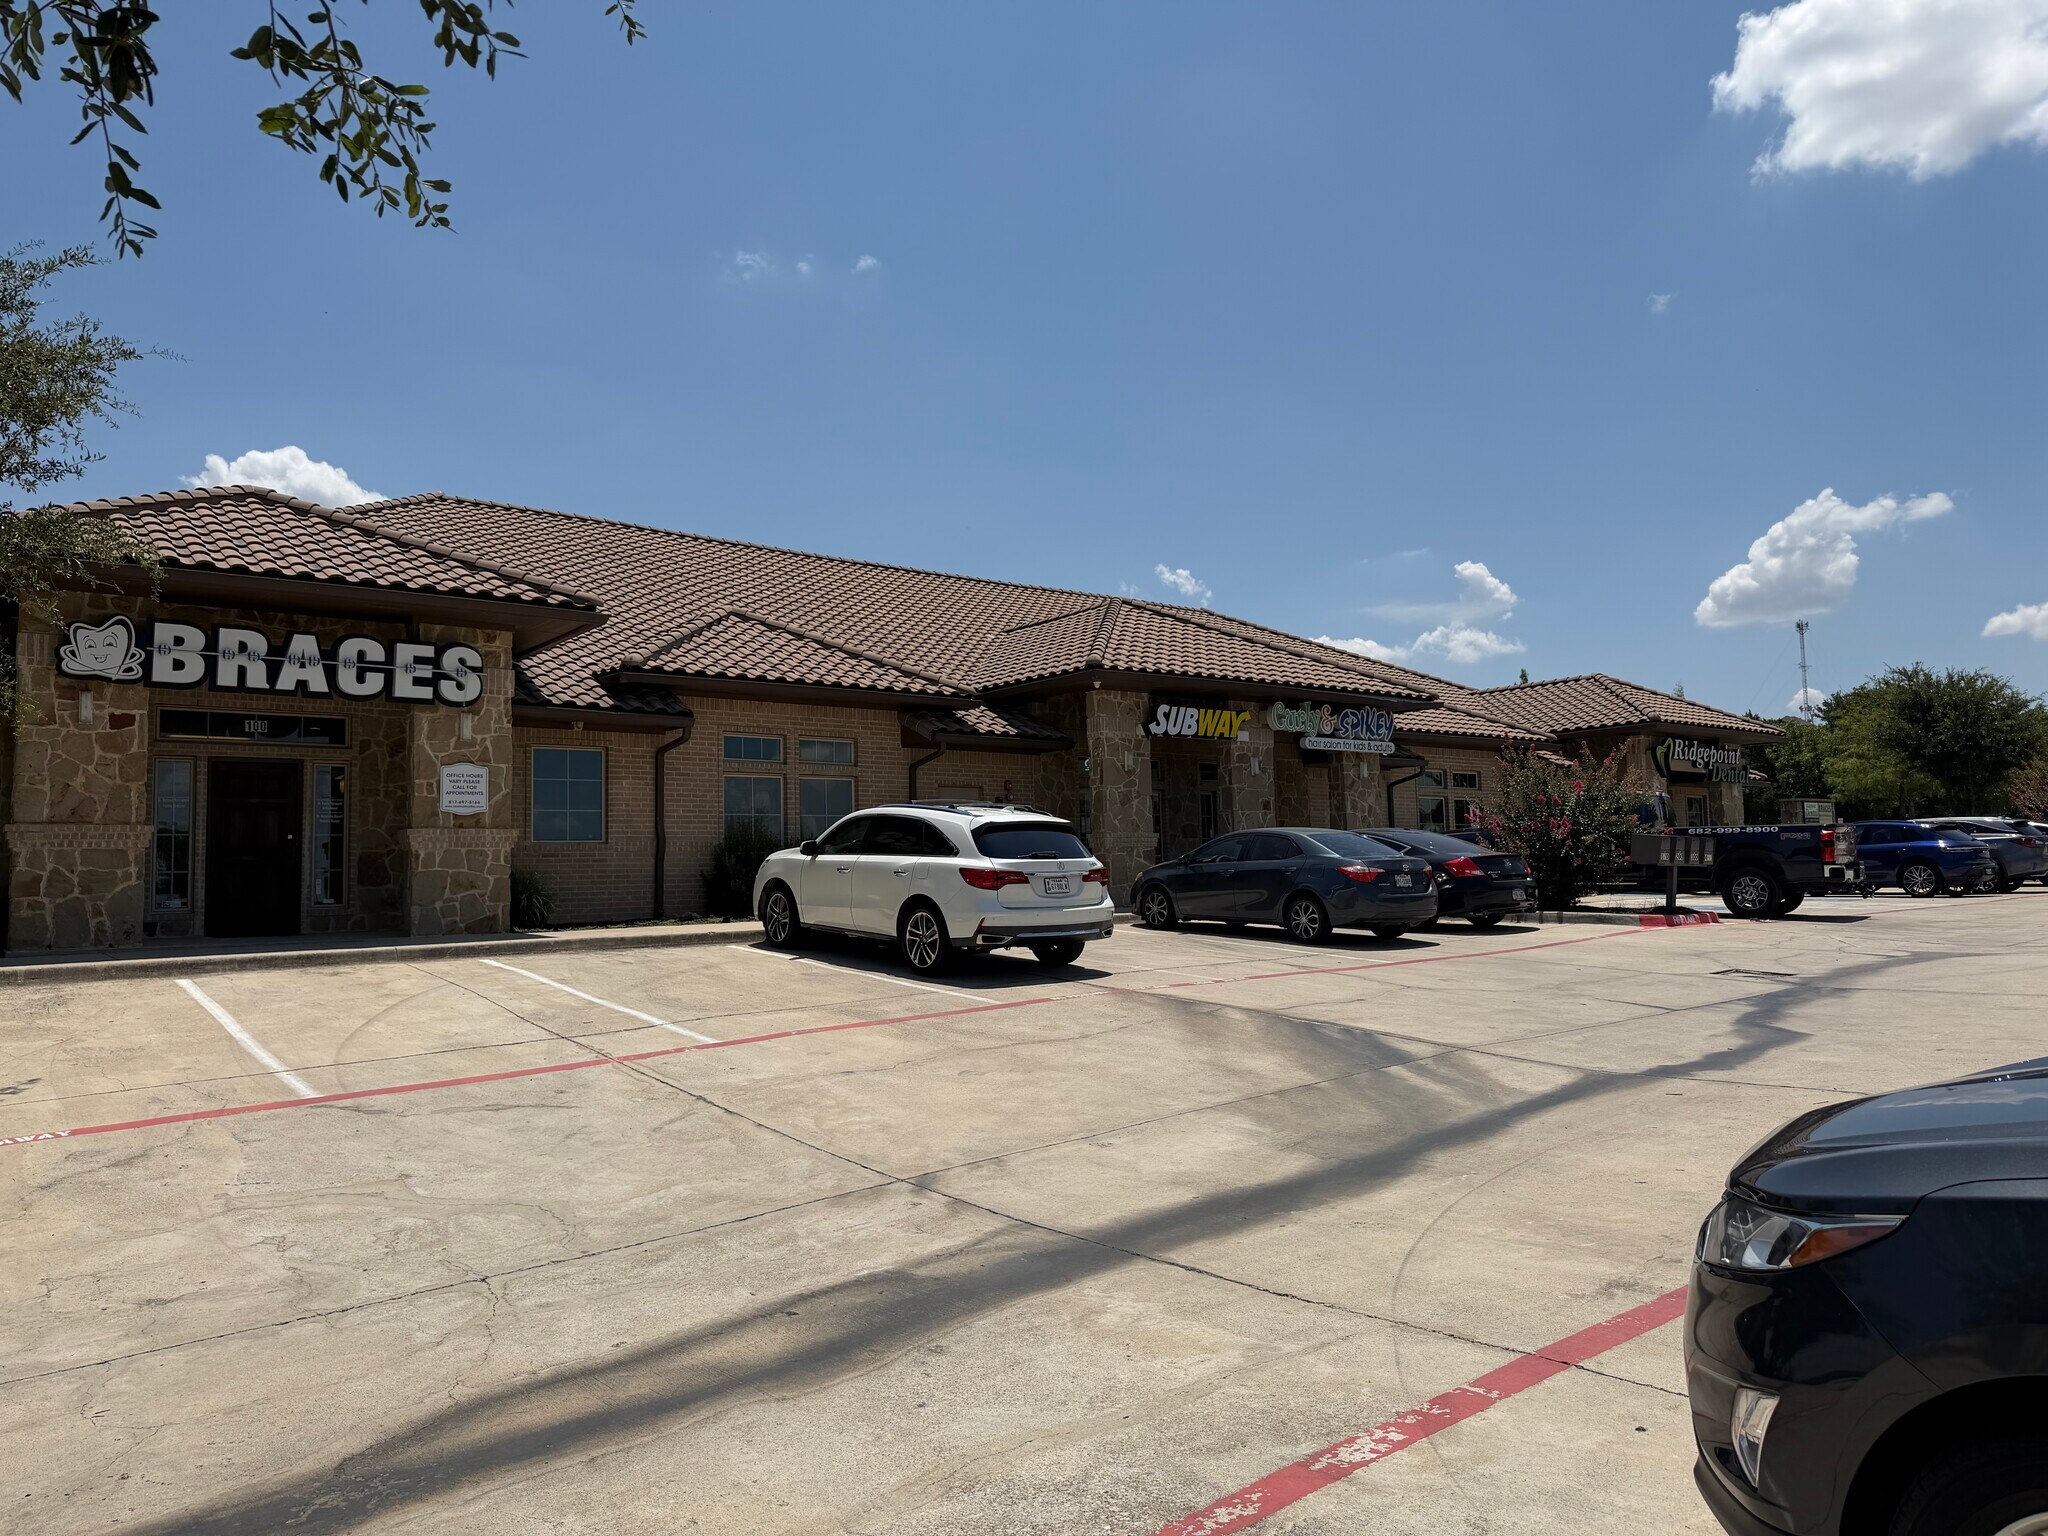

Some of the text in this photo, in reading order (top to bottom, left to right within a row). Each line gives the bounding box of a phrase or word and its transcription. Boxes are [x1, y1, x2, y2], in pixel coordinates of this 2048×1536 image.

[151, 622, 483, 703] BRACES
[246, 721, 267, 732] 100
[1149, 704, 1252, 738] SUBWAY
[1271, 701, 1395, 741] Curly & SPIKEY
[1308, 739, 1322, 748] hair
[1323, 740, 1342, 749] salon
[1343, 741, 1352, 750] for
[1353, 741, 1366, 751] kids
[1373, 743, 1393, 753] adults
[1673, 739, 1741, 769] Ridgepoint
[1712, 763, 1750, 783] Dental
[1688, 826, 1779, 835] 682-999-8900
